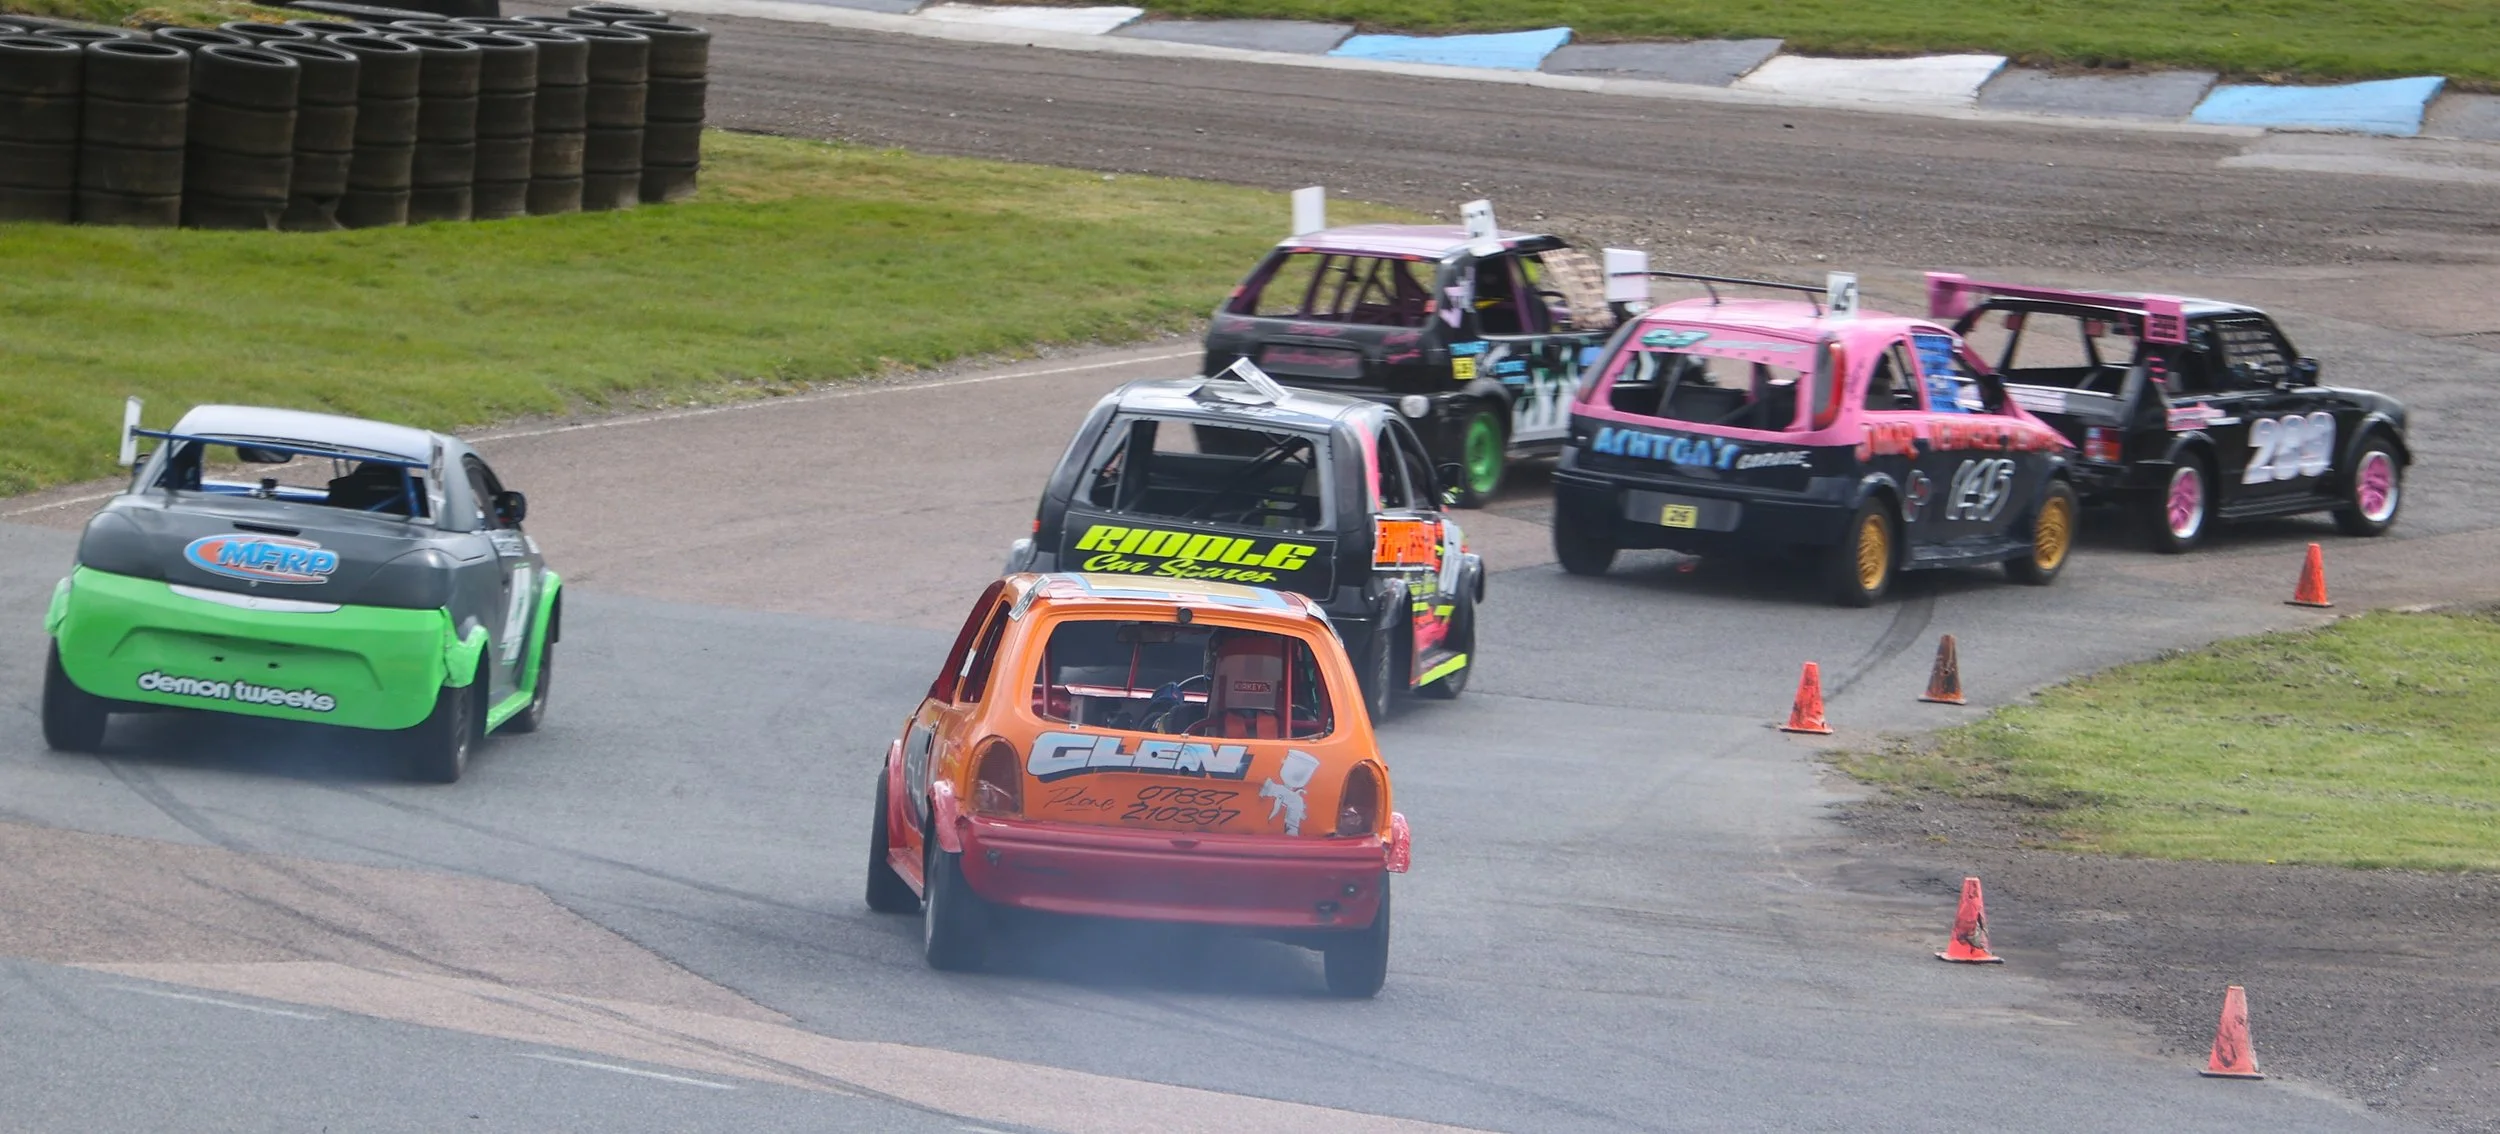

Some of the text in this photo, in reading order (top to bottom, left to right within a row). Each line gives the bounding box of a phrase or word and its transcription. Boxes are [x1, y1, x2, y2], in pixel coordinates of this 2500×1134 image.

[216, 539, 340, 578] MFRP
[1074, 524, 1318, 571] RIDDLE
[1082, 553, 1278, 582] Car Spares
[138, 670, 337, 711] demon tweeks
[1026, 731, 1252, 783] GLEN
[1043, 785, 1240, 811] Phone 07837
[1120, 803, 1242, 825] 210397
